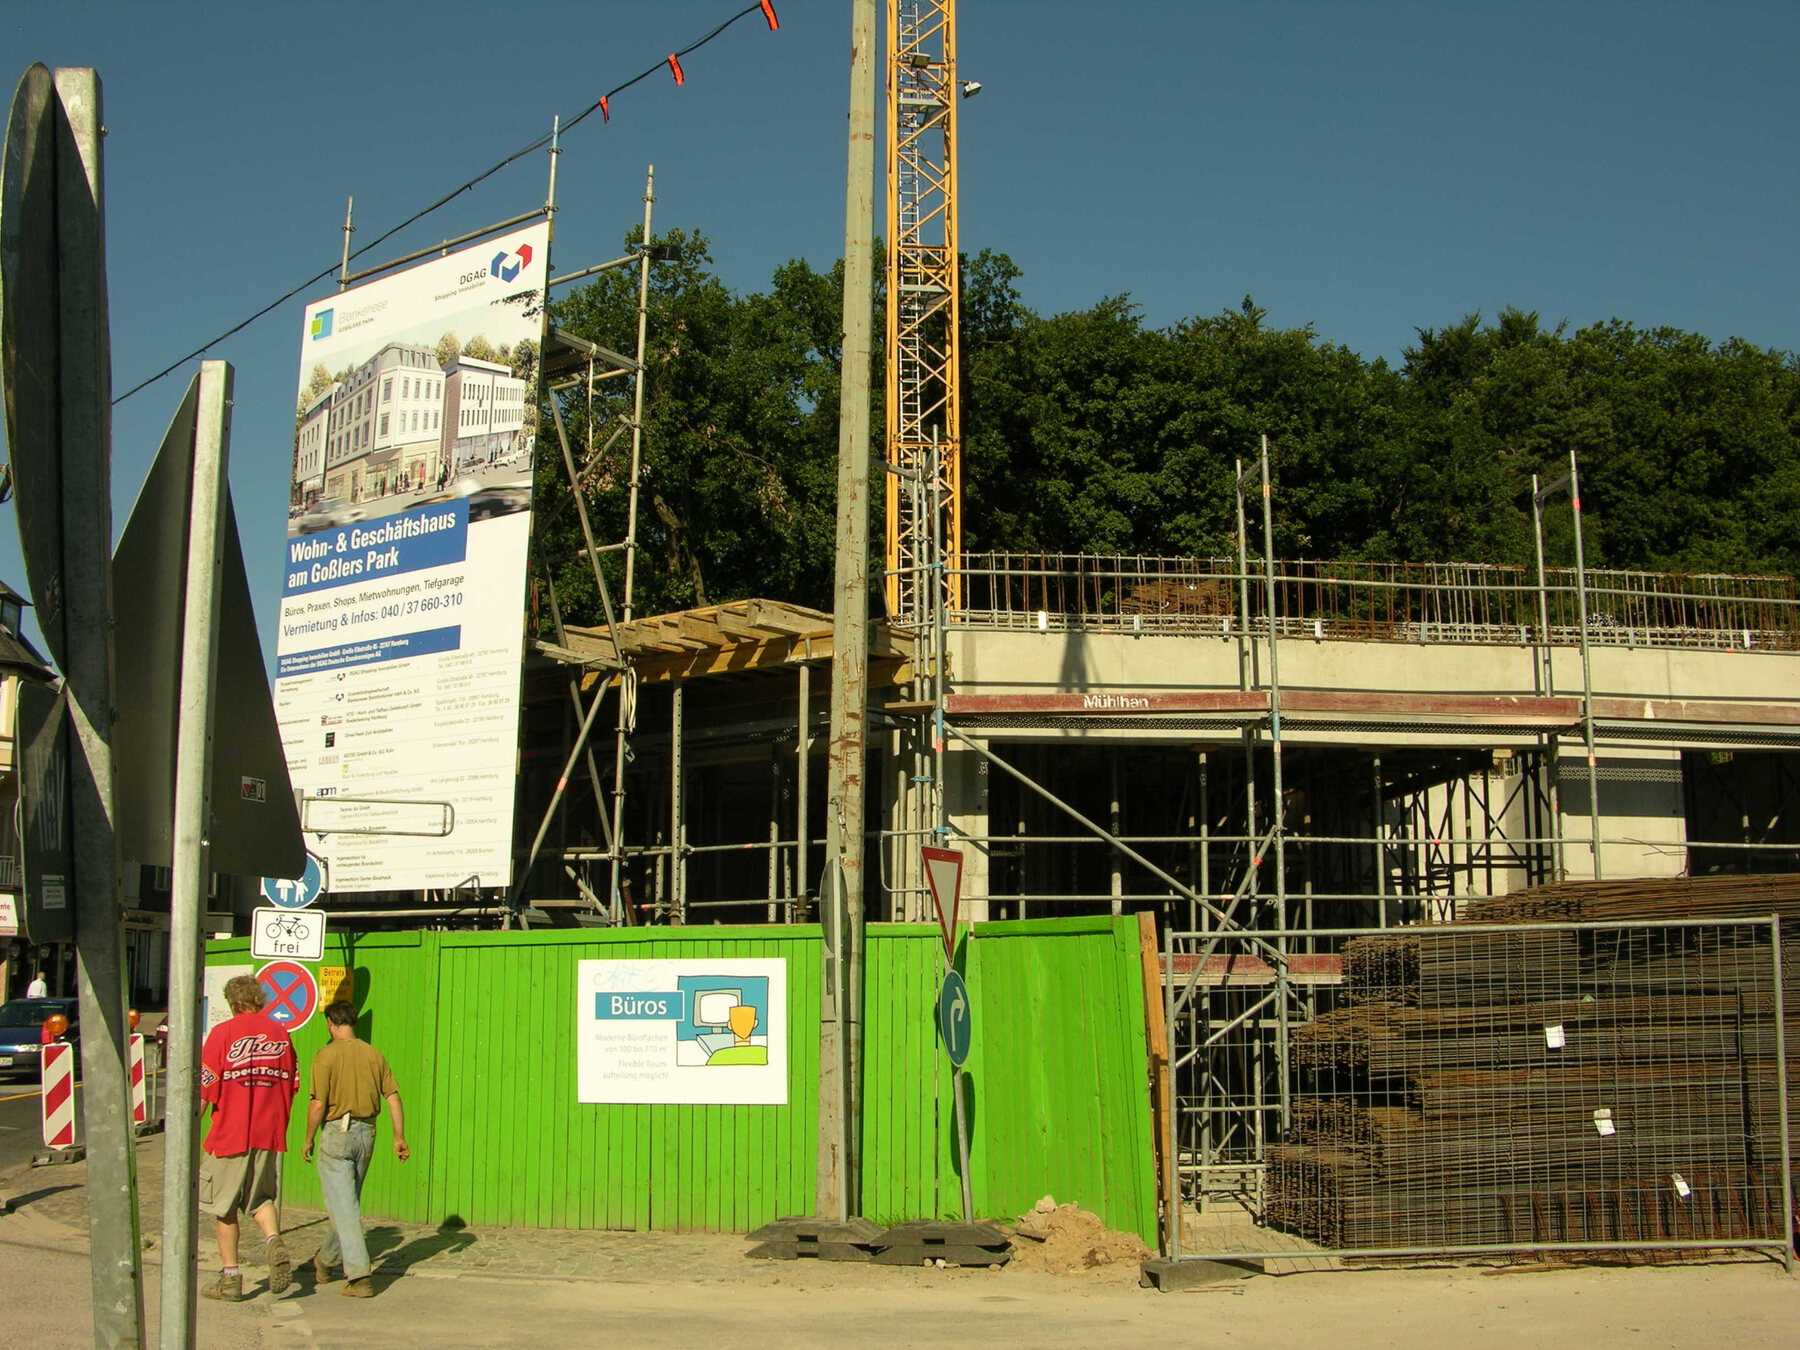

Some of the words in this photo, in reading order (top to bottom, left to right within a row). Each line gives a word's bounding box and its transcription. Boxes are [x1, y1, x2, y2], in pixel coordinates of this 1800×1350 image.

[459, 268, 487, 285] DGAG
[290, 539, 333, 563] Wohn-
[336, 532, 347, 553] &
[351, 512, 456, 549] Geschäftshaus
[288, 570, 308, 588] am
[311, 557, 363, 584] Goßlers
[366, 546, 399, 571] Park
[424, 575, 464, 591] Tiefgarage
[283, 617, 338, 637] Vermietung
[341, 613, 348, 626] &
[351, 608, 378, 624] Infos:
[381, 604, 399, 619] 040
[406, 600, 419, 614] 37
[420, 592, 463, 611] 660-310
[1083, 694, 1149, 709] Mühlhan
[274, 940, 299, 953] frei
[611, 995, 667, 1015] Büros
[595, 1034, 627, 1042] Moderne
[226, 1034, 290, 1065] Thor
